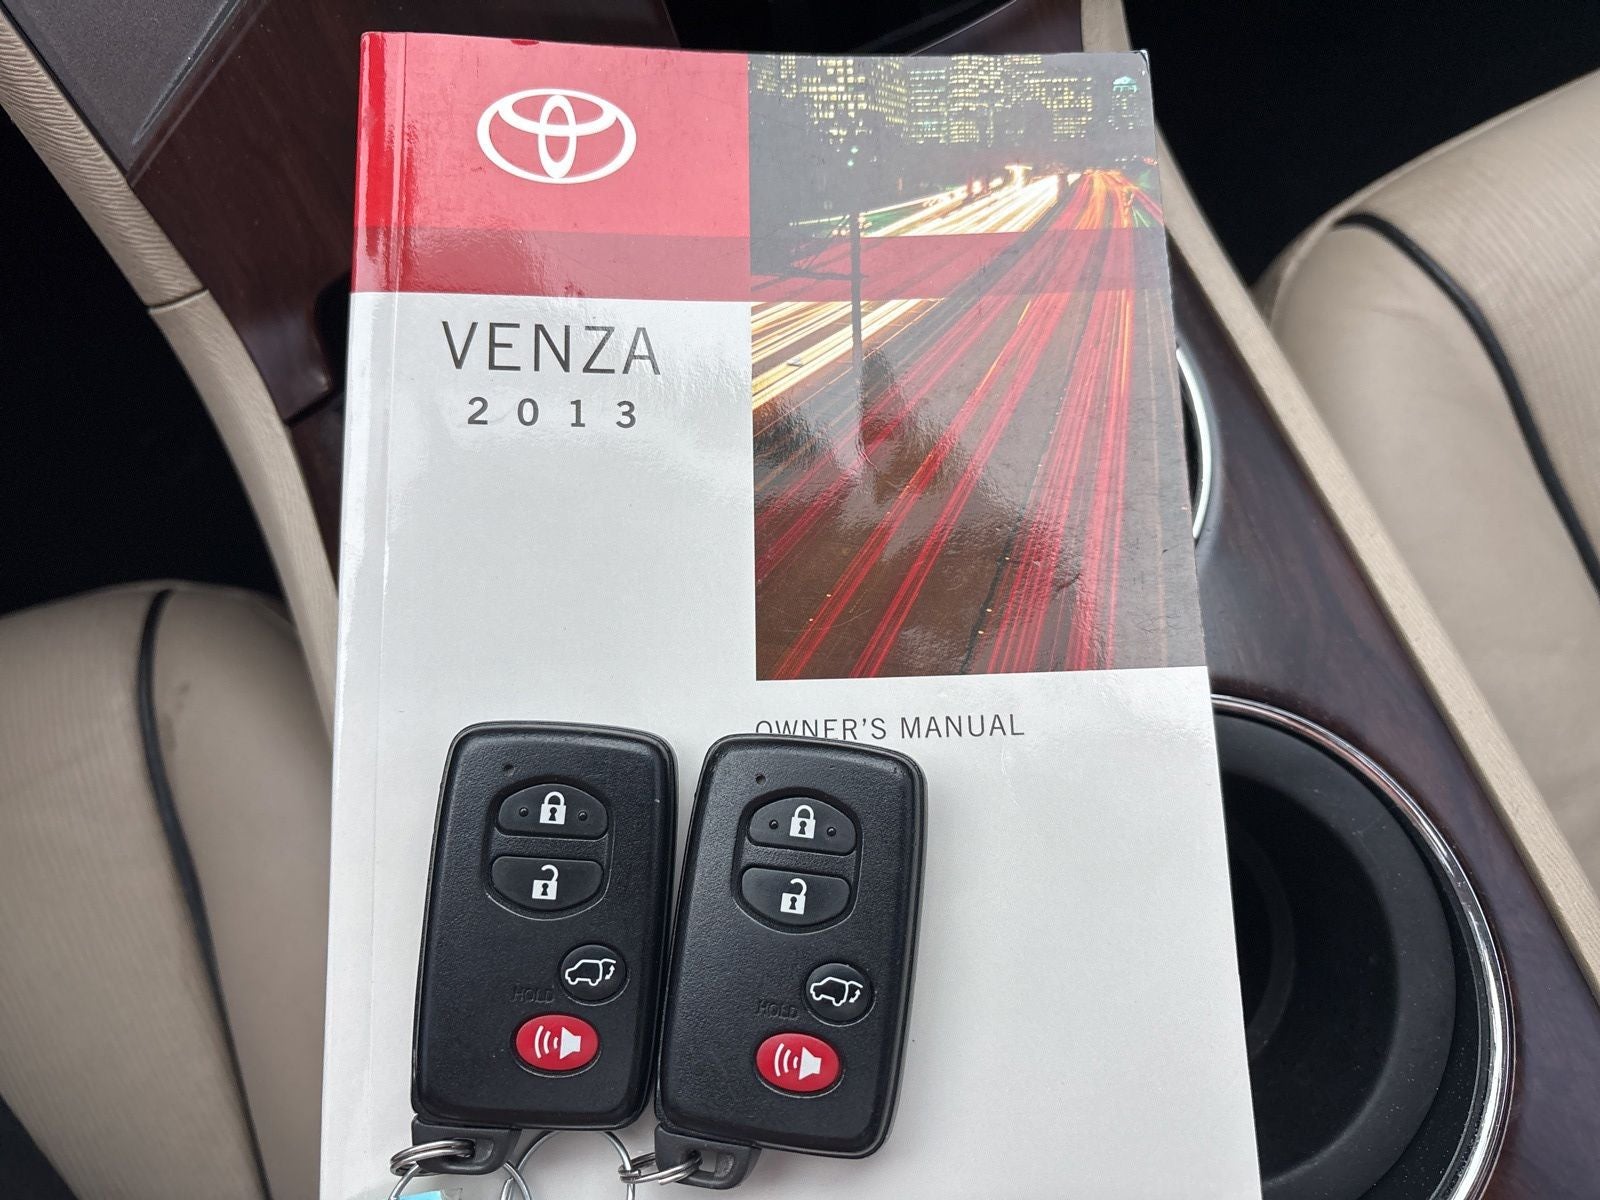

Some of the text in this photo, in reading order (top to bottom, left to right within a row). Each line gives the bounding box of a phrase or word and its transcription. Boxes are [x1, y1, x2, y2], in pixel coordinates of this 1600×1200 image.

[441, 320, 661, 376] VENZA
[467, 396, 637, 429] 2013
[900, 713, 1025, 739] MANUAL
[511, 986, 555, 1004] HOLD
